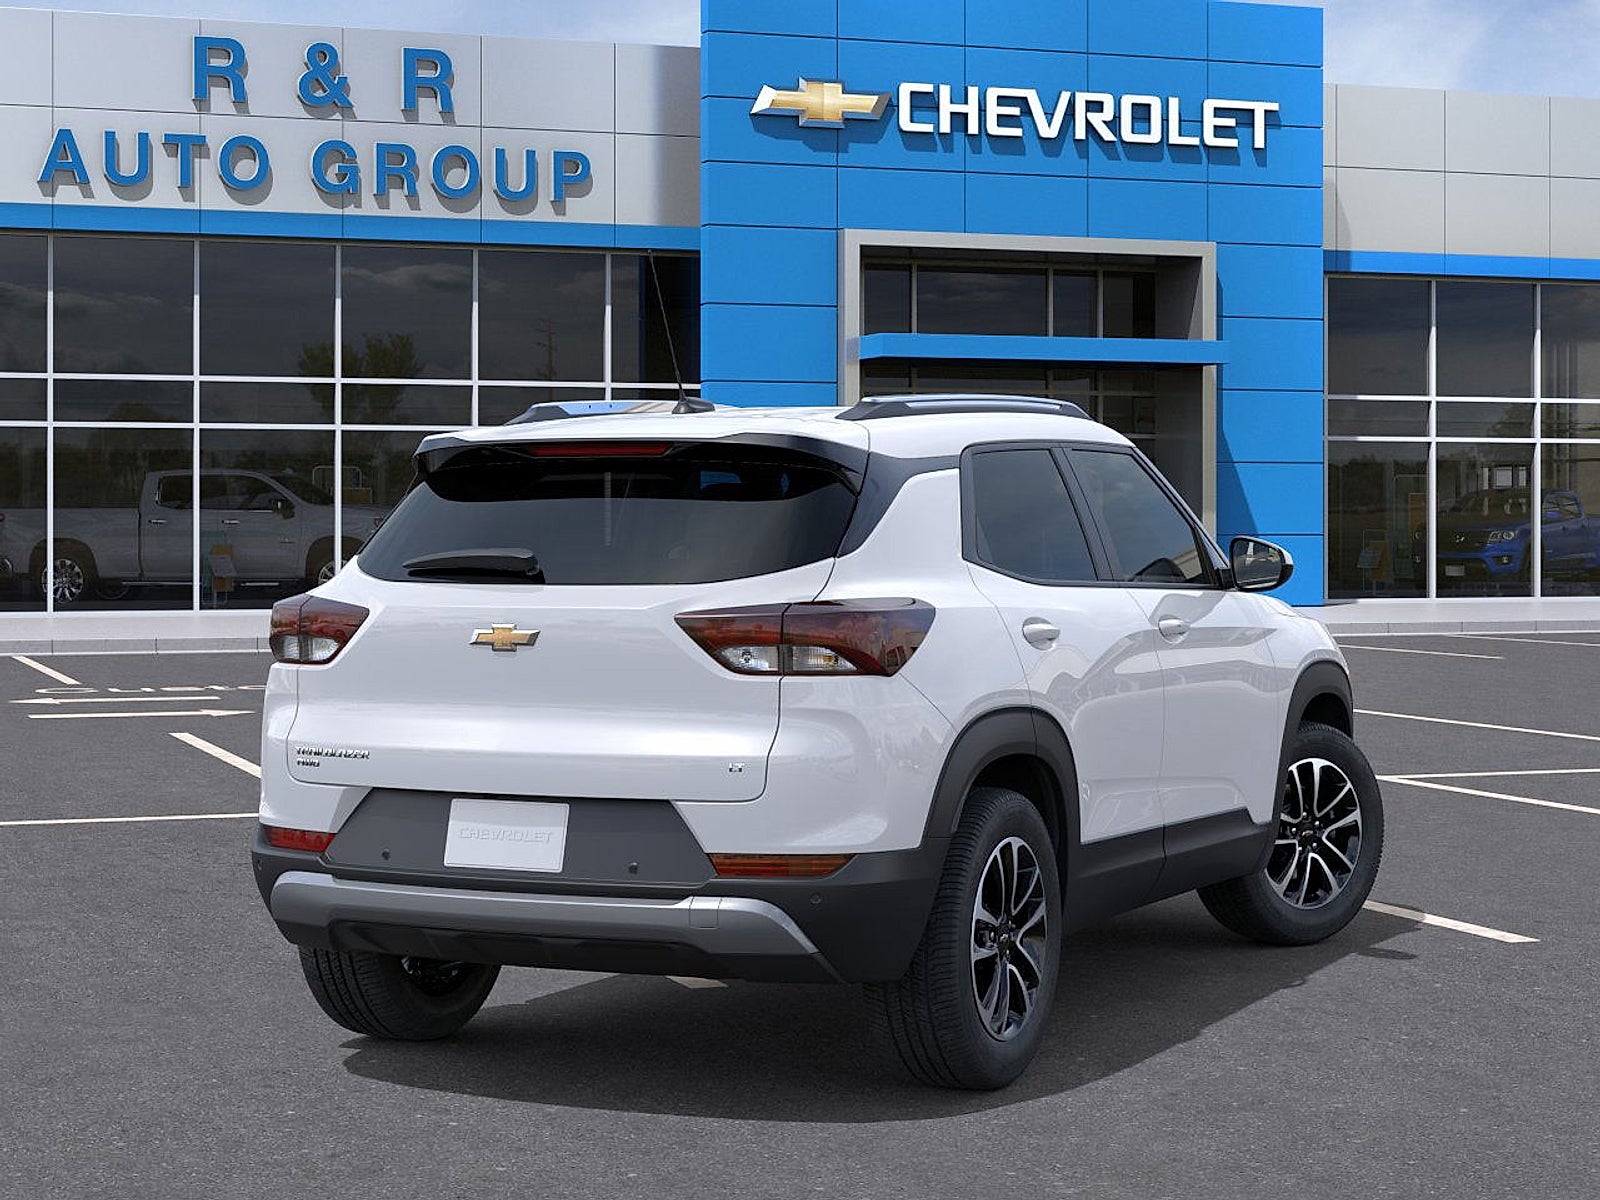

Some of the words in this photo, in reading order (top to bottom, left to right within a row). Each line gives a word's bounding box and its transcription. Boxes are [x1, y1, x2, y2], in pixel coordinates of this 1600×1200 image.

[191, 35, 248, 103] R
[297, 41, 354, 109] &
[400, 47, 455, 112] R
[898, 82, 1280, 150] CHEVROLET
[38, 128, 271, 192] AUTO
[311, 139, 593, 202] GROUP
[295, 746, 370, 759] TRAILBLAZER
[459, 827, 554, 844] CHEVROLET
